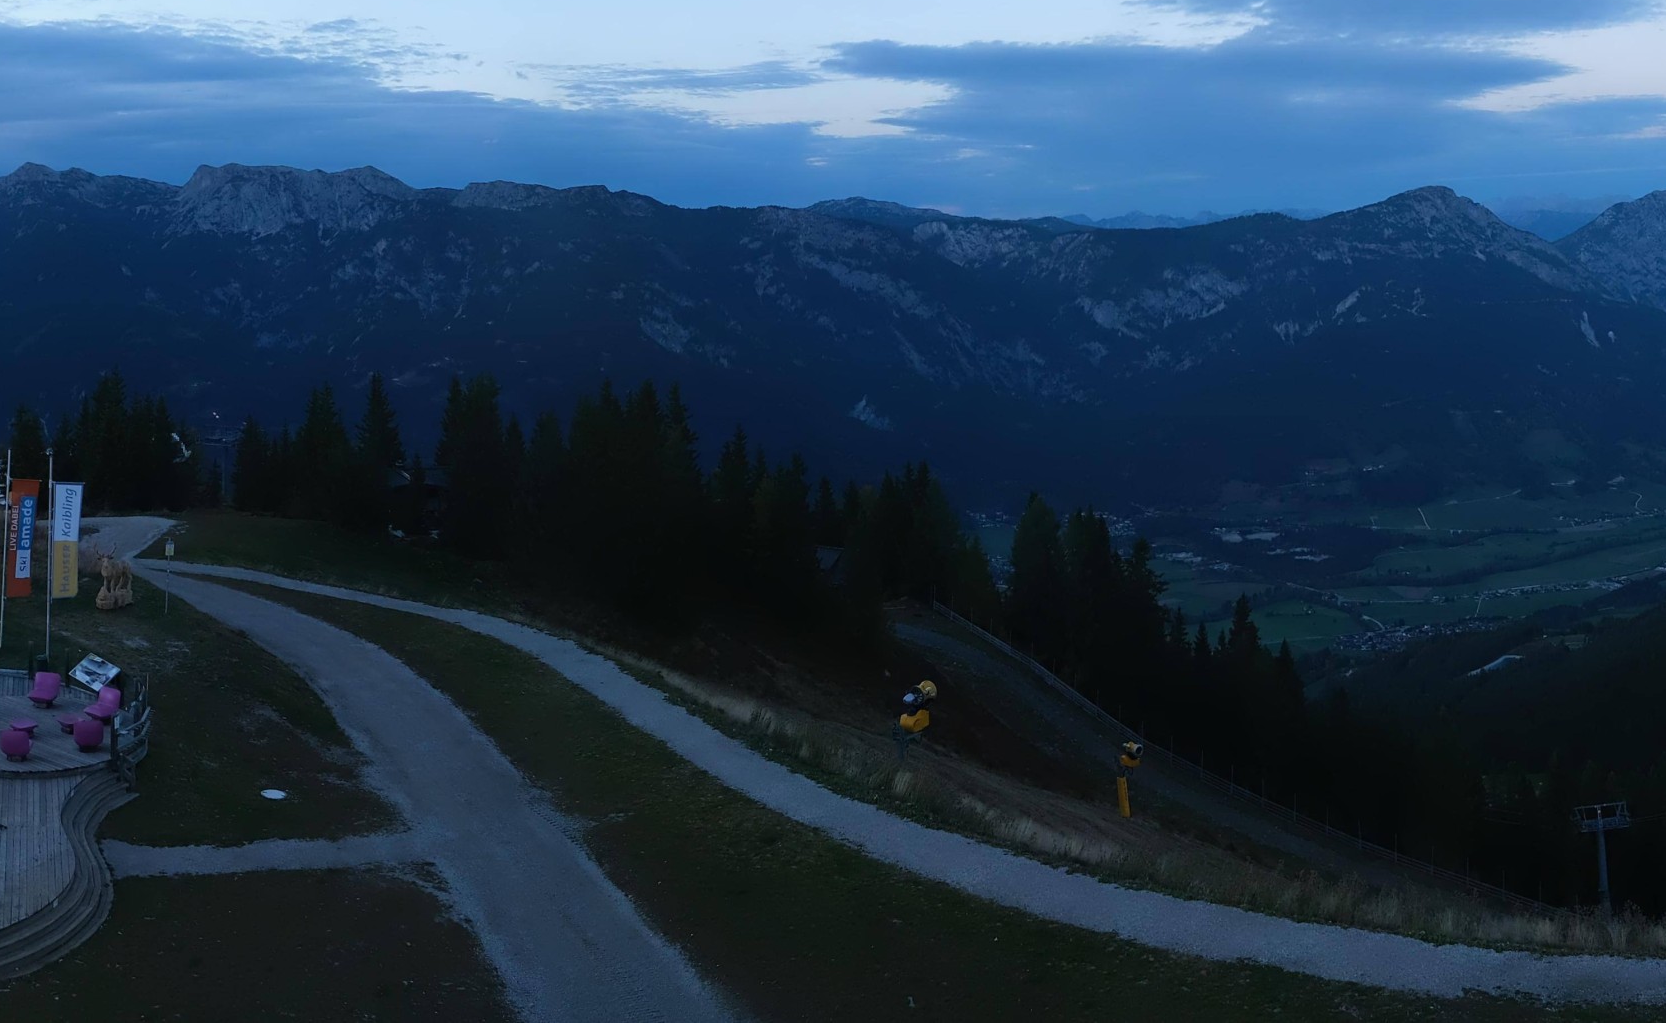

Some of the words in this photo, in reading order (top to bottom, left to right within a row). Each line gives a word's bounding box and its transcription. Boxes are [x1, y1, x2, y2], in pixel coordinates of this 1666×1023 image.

[11, 505, 20, 531] DABEI
[62, 487, 77, 537] Kaibling
[9, 531, 18, 551] LIVE
